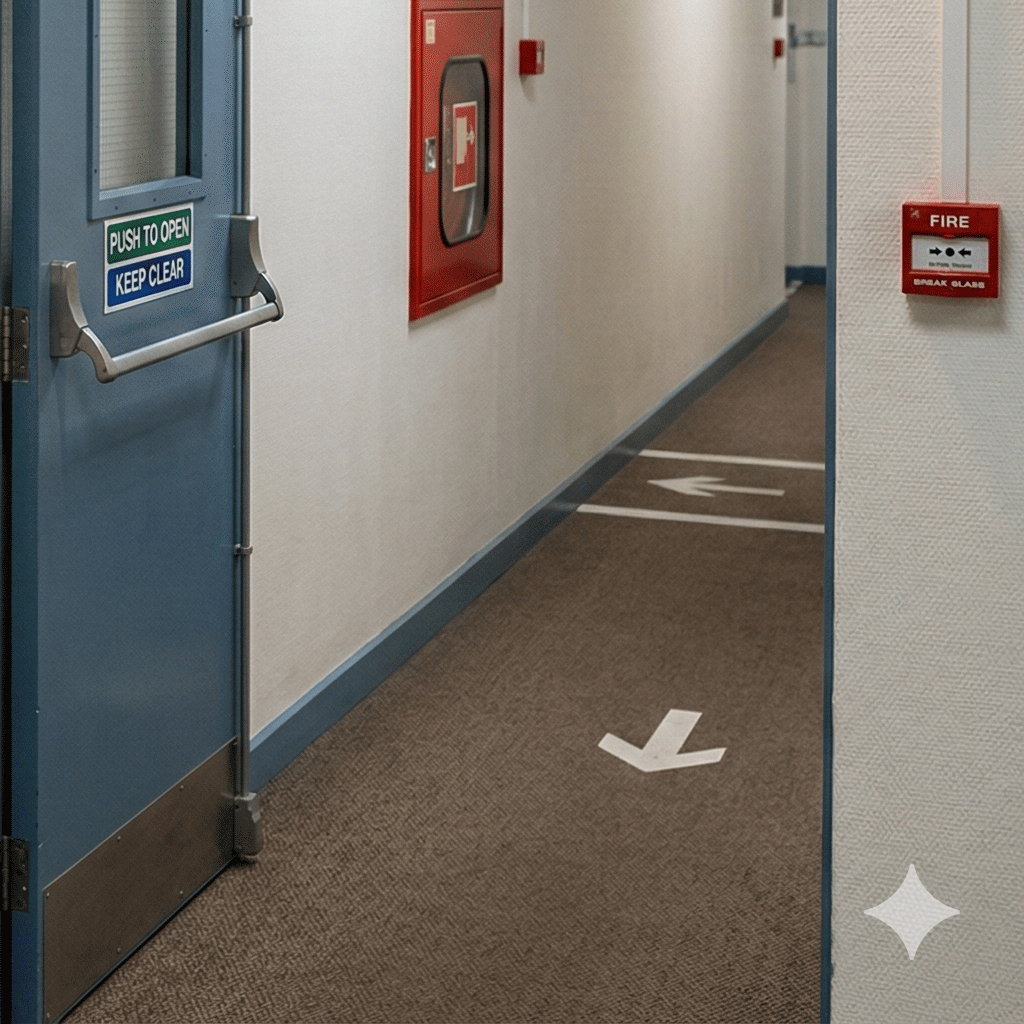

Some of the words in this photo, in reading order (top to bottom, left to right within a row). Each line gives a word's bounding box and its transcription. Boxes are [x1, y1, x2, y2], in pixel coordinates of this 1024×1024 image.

[110, 226, 141, 255] PUSH
[143, 223, 158, 246] TO
[161, 216, 189, 243] OPEN
[930, 215, 969, 228] FIRE
[116, 267, 146, 296] KEEP
[148, 257, 184, 287] CLEAR
